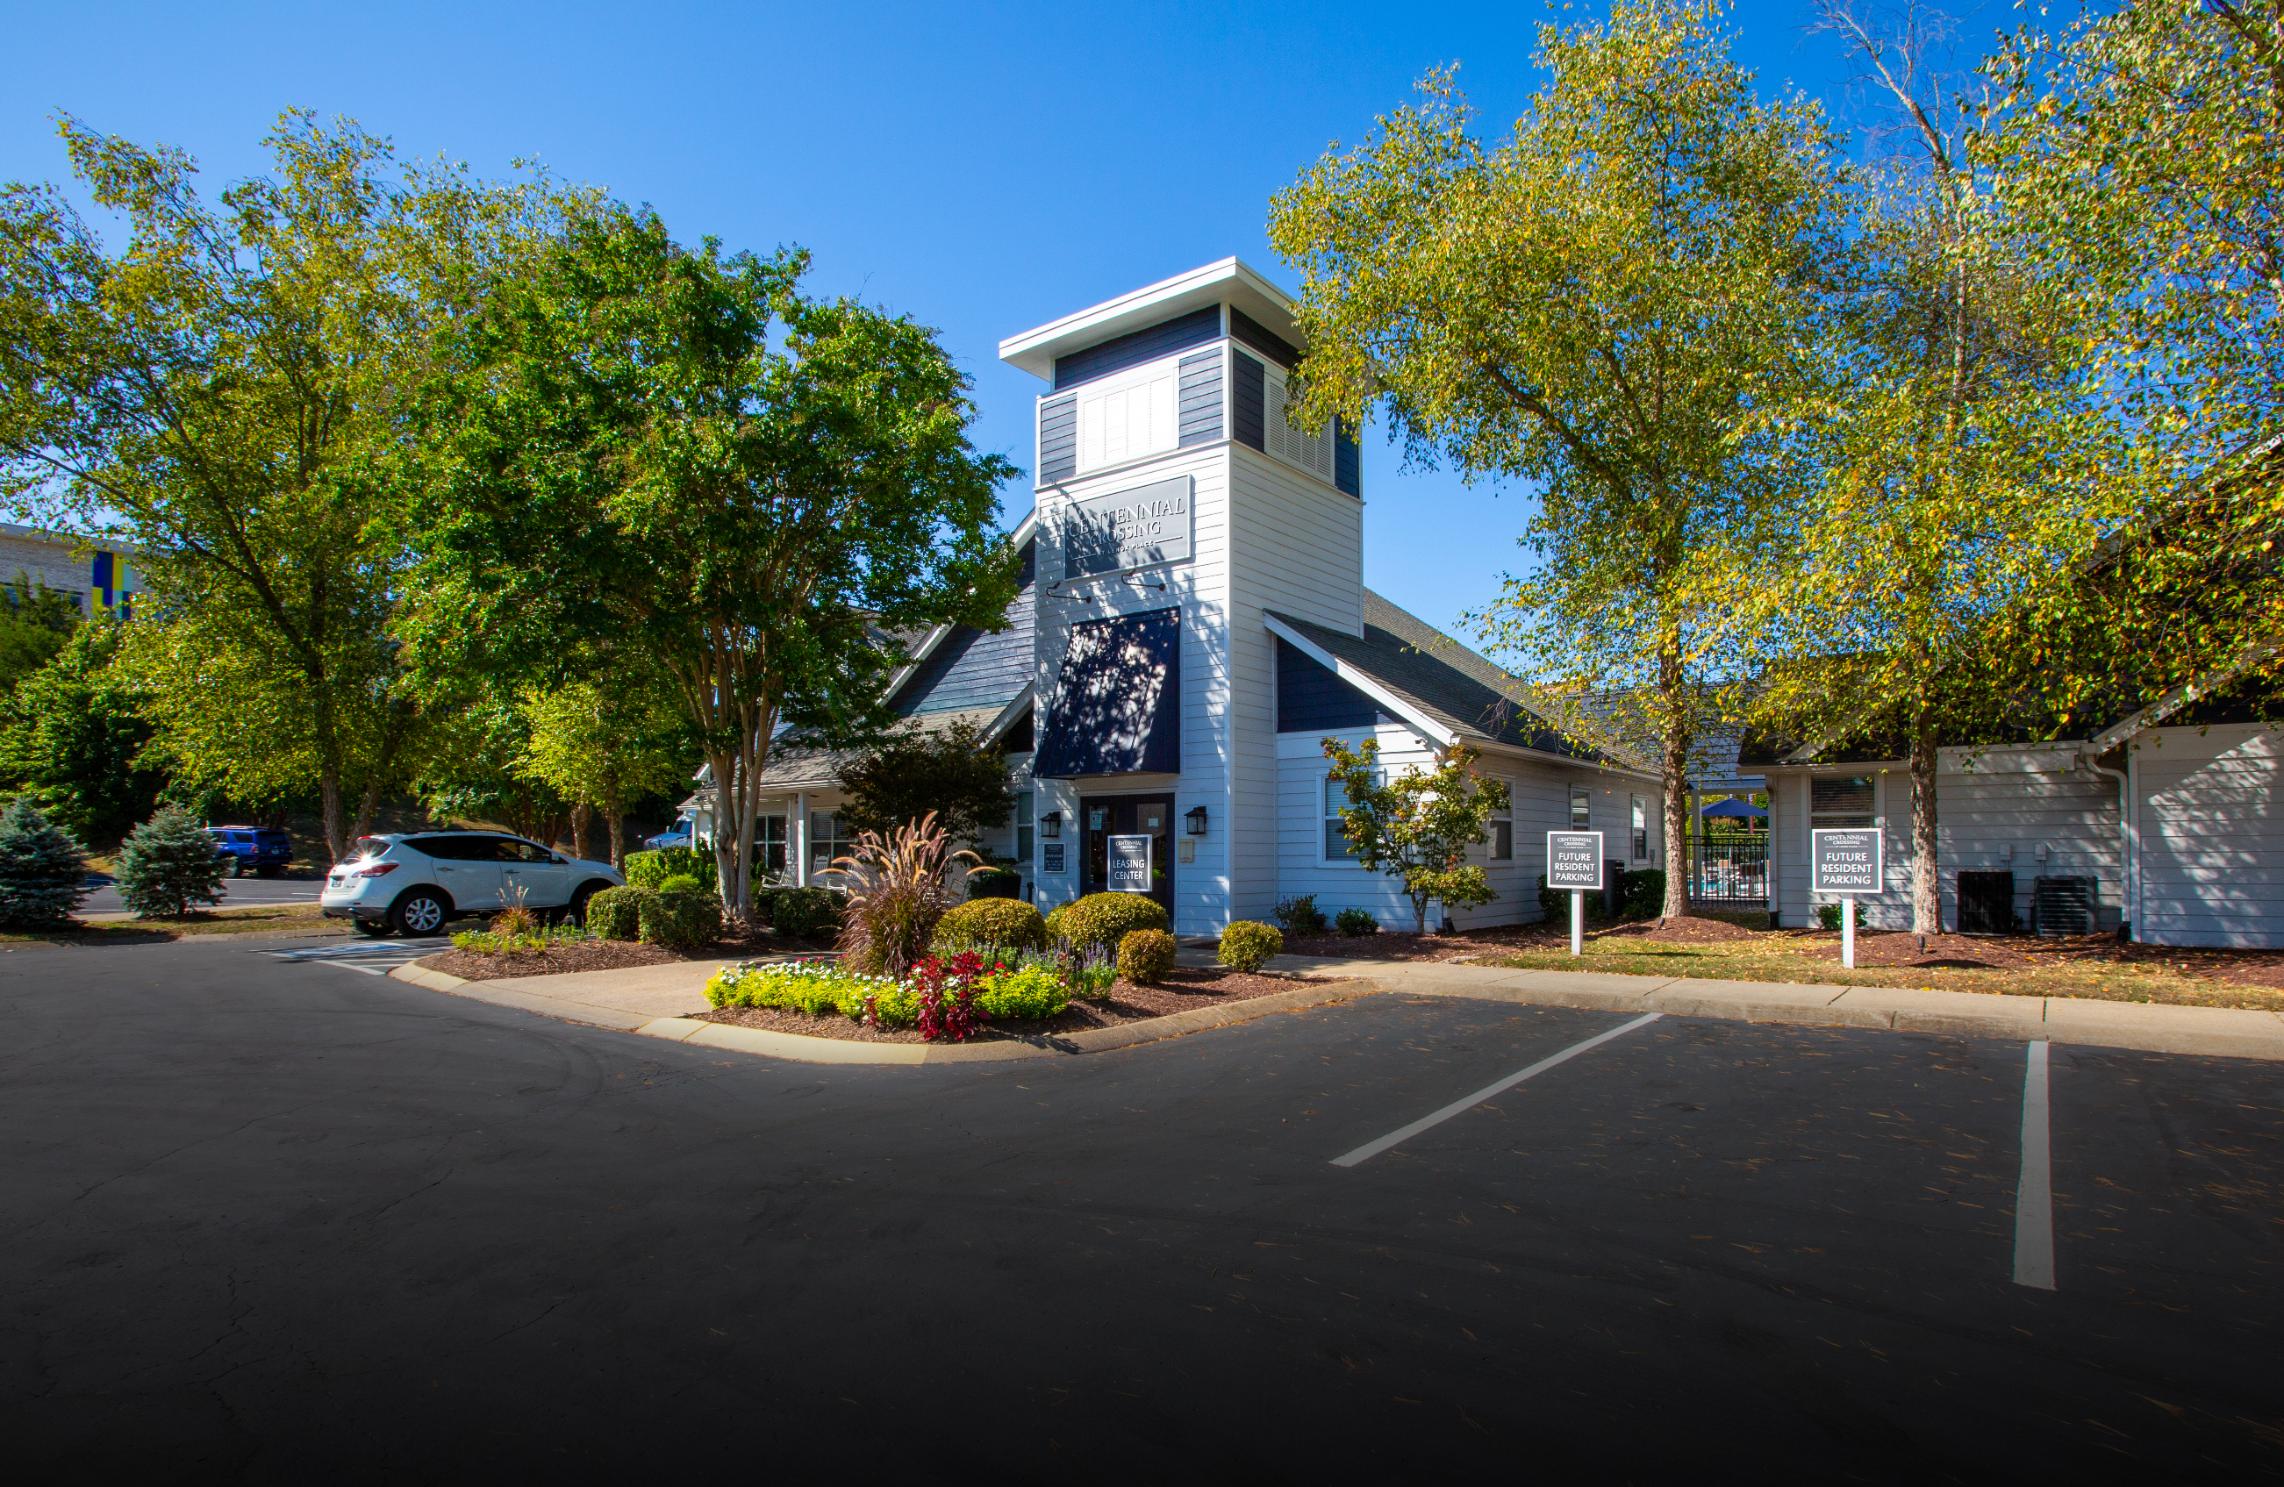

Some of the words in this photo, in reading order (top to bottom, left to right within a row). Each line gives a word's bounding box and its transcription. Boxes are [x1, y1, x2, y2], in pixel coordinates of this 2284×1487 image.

[1069, 498, 1185, 537] CENTENNIAL
[1090, 521, 1161, 546] CROSSING
[1558, 852, 1592, 861] FUTURE
[1826, 852, 1868, 862] FUTURE
[1112, 859, 1145, 869] LEASING
[1554, 863, 1595, 871] RESIDENT
[1821, 863, 1873, 873] RESIDENT
[1114, 871, 1143, 880] CENTER
[1555, 873, 1594, 882] PARKING
[1823, 875, 1871, 885] PARKING
